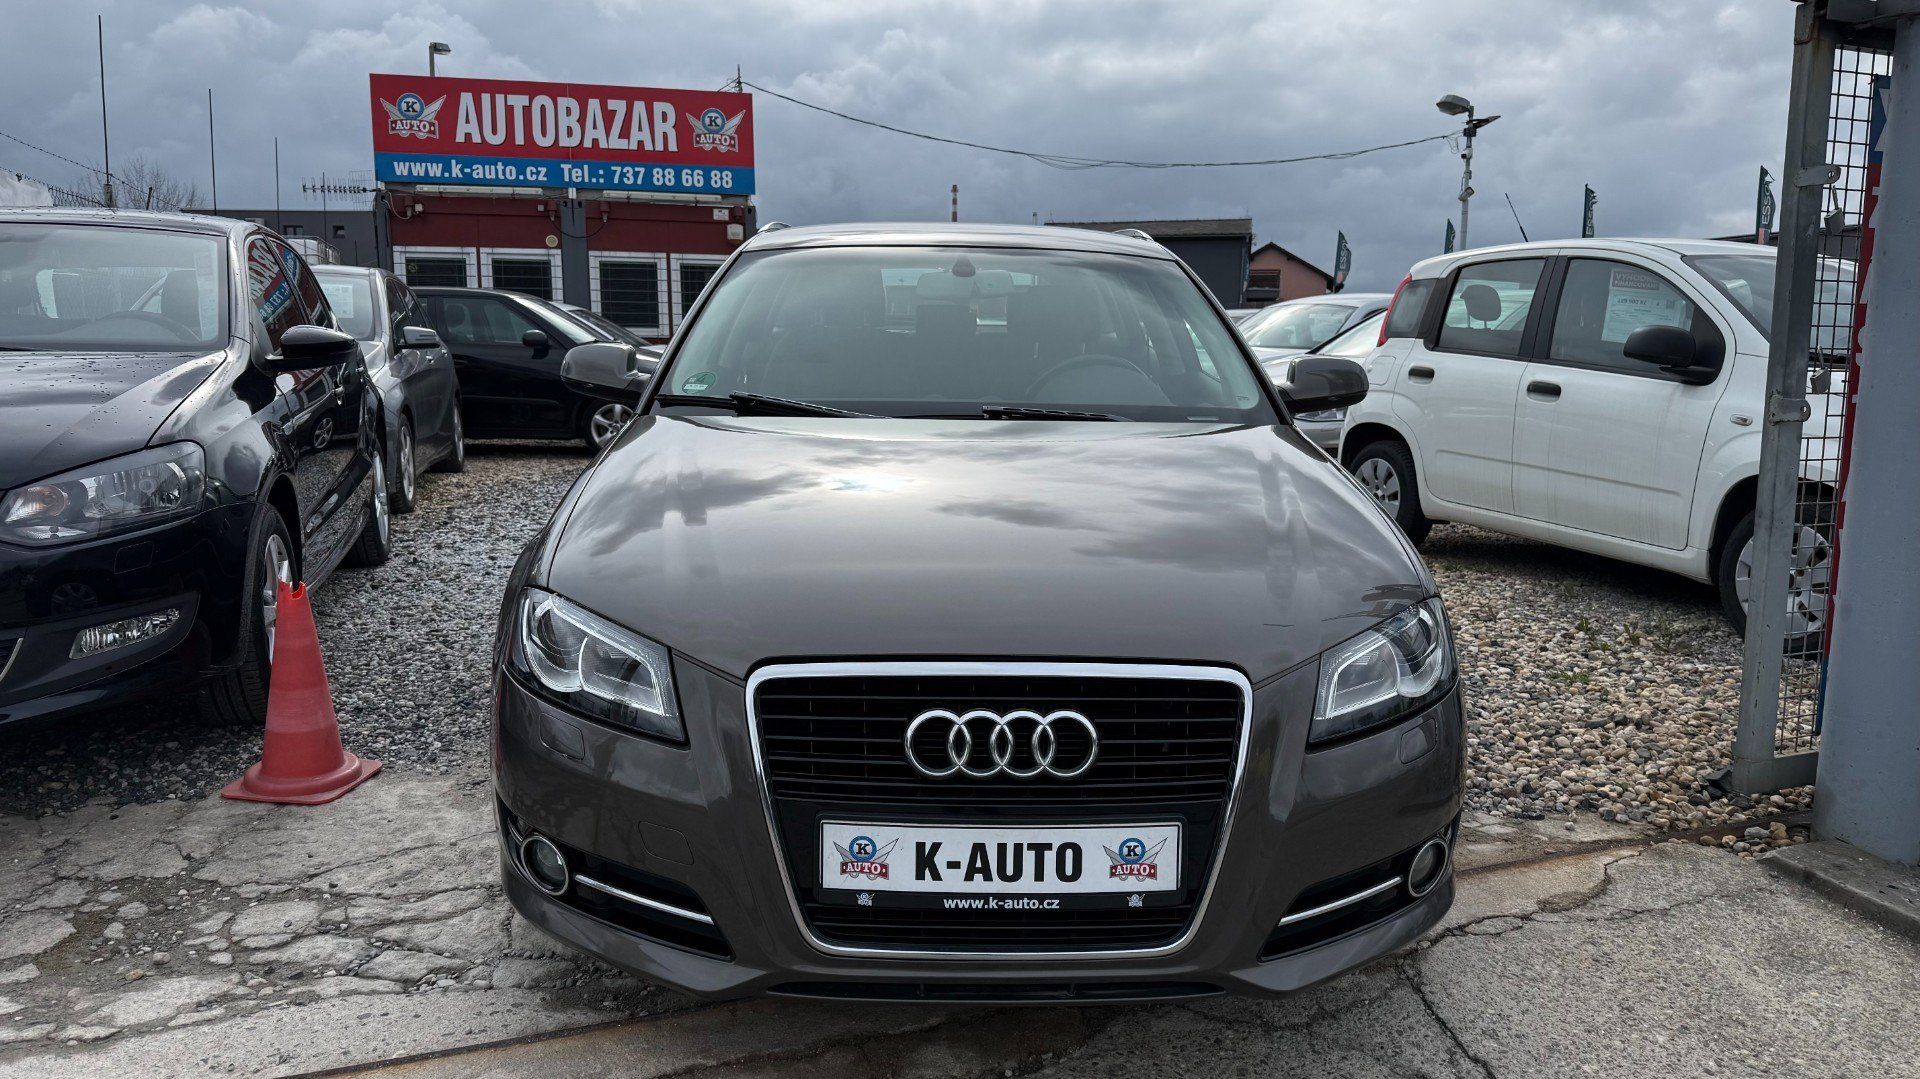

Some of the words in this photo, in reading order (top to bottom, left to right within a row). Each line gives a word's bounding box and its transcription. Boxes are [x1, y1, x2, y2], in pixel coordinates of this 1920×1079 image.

[403, 101, 418, 113] K
[395, 120, 430, 132] AUTO
[455, 92, 679, 152] AUTOBAZAR
[707, 115, 720, 127] K
[700, 134, 731, 146] AUTO
[393, 159, 548, 182] www.k-auto.cz
[560, 163, 604, 184] Tel.:
[611, 166, 646, 186] 737
[652, 167, 676, 187] 88
[681, 169, 705, 188] 66
[710, 170, 734, 189] 88
[855, 842, 870, 855] K
[1125, 845, 1140, 857] K
[846, 862, 881, 874] AUTO
[915, 841, 1083, 883] K-AUTO
[1115, 864, 1150, 875] AUTO
[943, 896, 1060, 909] www.k-auto.cz
